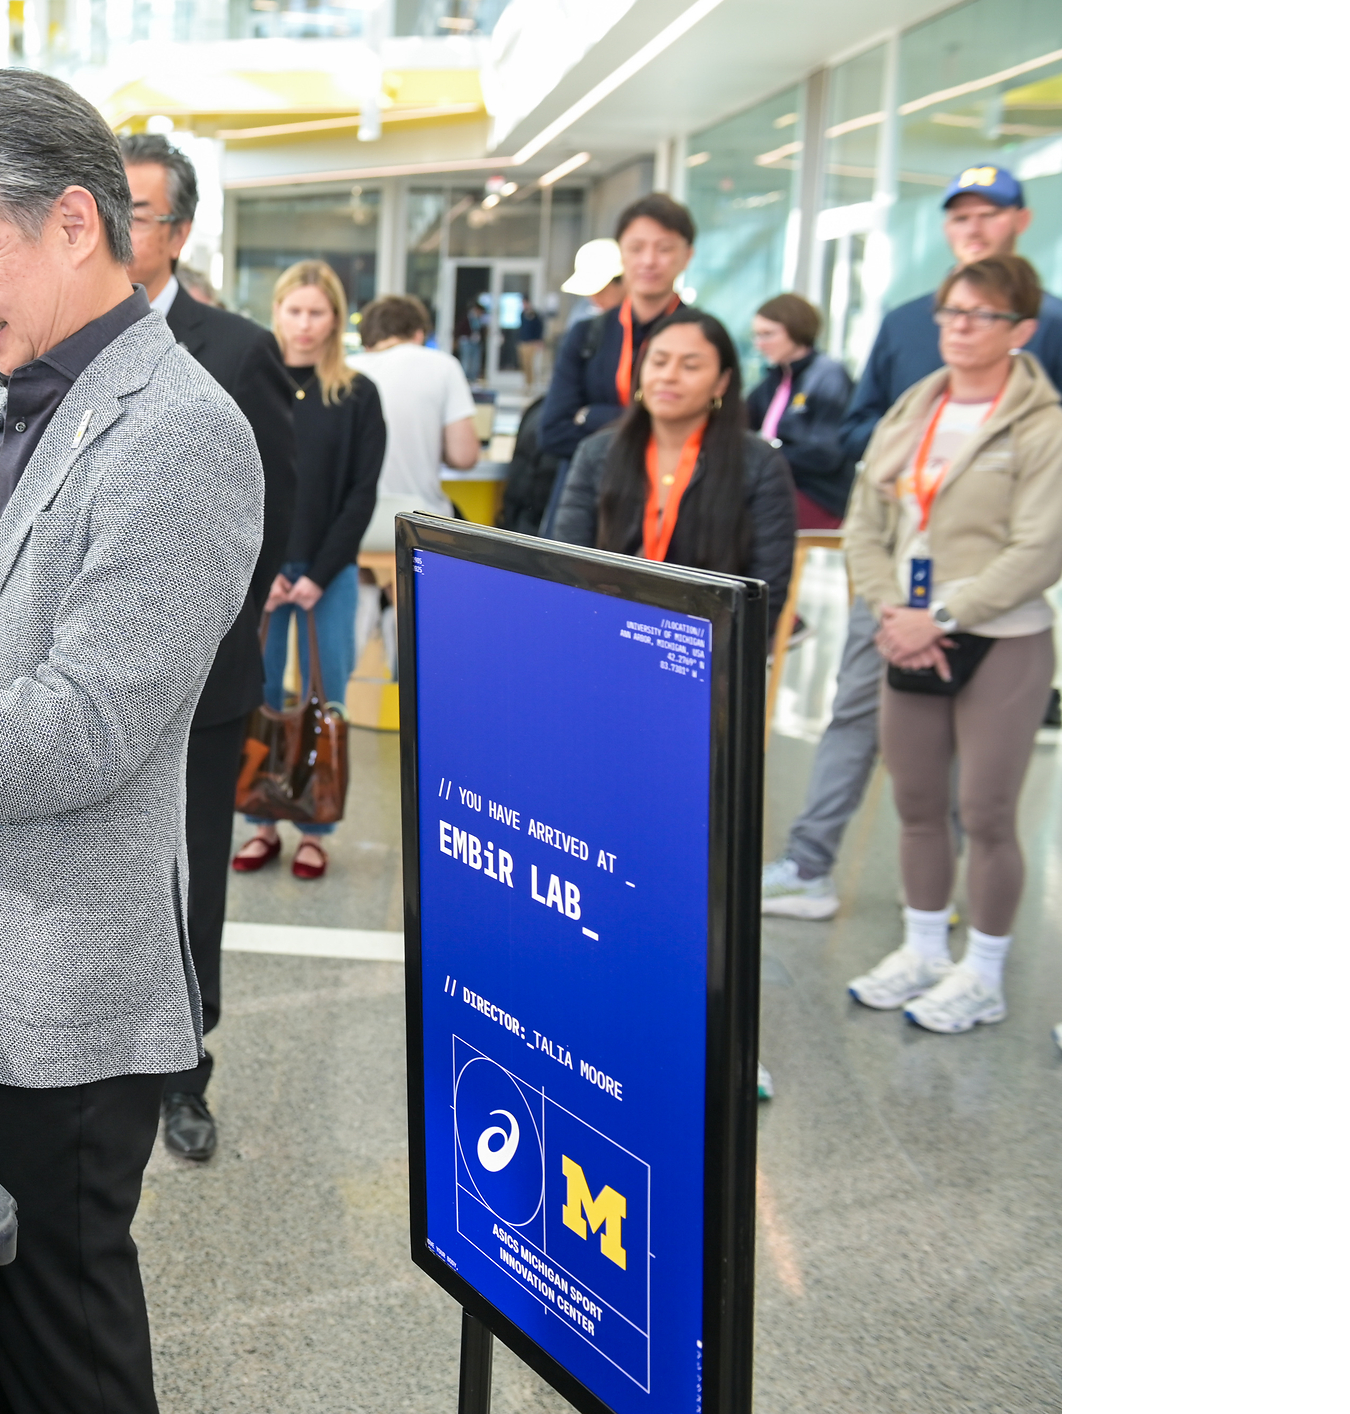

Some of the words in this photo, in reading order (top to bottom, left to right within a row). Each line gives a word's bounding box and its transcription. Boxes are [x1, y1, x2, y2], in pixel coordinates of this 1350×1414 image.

[620, 629, 632, 639] ANN
[633, 632, 654, 646] ARBOR,
[656, 638, 690, 656] MICHIGAN,
[692, 648, 705, 659] USA
[626, 620, 662, 636] UNIVERSITY
[663, 629, 672, 639] OF
[674, 632, 705, 648] MICHIGAN
[660, 618, 705, 638] //LOCATION//
[439, 819, 514, 889] EMBiR
[458, 786, 482, 812] YOU
[488, 800, 521, 831] HAVE
[528, 818, 589, 861] ARRIVED
[597, 849, 618, 874] AT
[580, 1059, 623, 1102] MOORE
[562, 1154, 627, 1271] M
[492, 1223, 519, 1254] ASICS
[520, 1244, 569, 1295] MICHIGAN
[570, 1285, 604, 1322] SPORT
[500, 1246, 555, 1304] INNOVATION
[556, 1295, 595, 1337] CENTER
